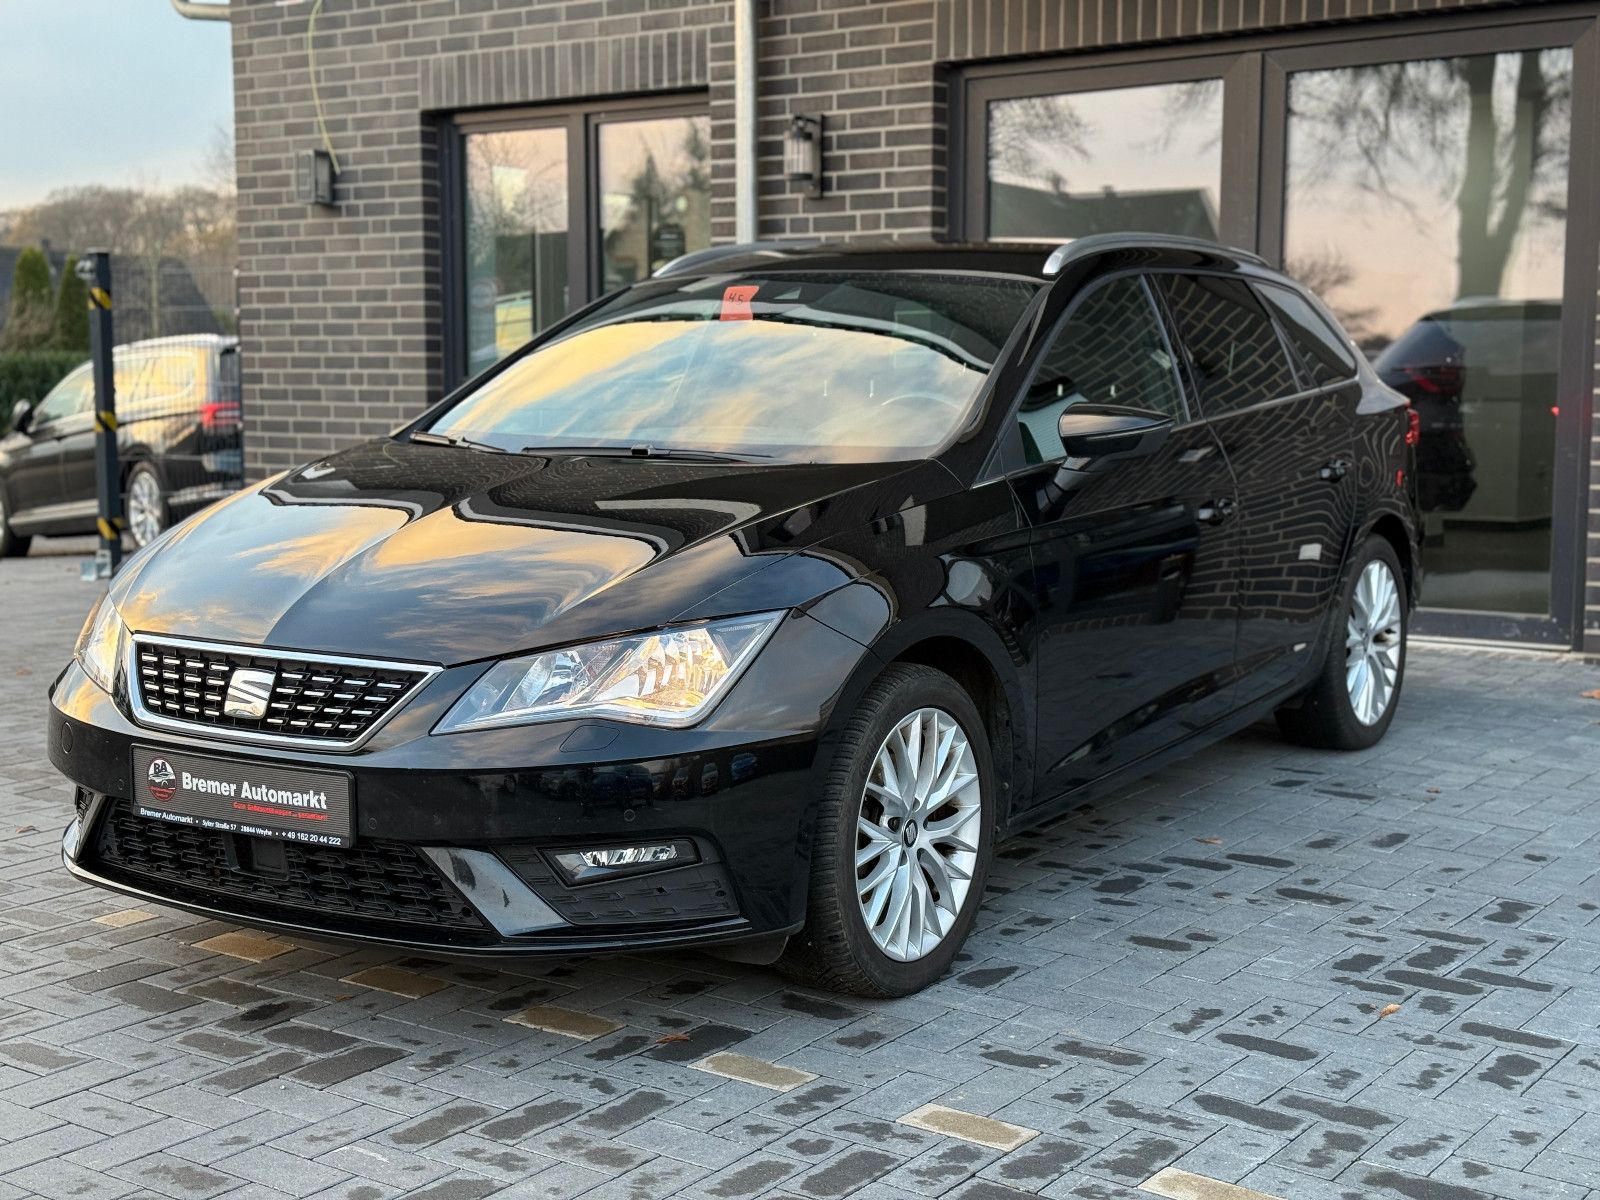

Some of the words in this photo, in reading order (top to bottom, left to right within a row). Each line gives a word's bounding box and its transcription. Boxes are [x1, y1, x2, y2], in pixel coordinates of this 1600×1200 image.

[153, 762, 167, 774] BA
[182, 772, 236, 796] Bremer
[241, 782, 327, 809] Automarkt
[140, 807, 161, 818] Bremer
[162, 812, 193, 824] Automarkt
[297, 832, 309, 841] 162
[309, 834, 318, 843] 20
[319, 835, 328, 844] 44
[328, 837, 341, 845] 222
